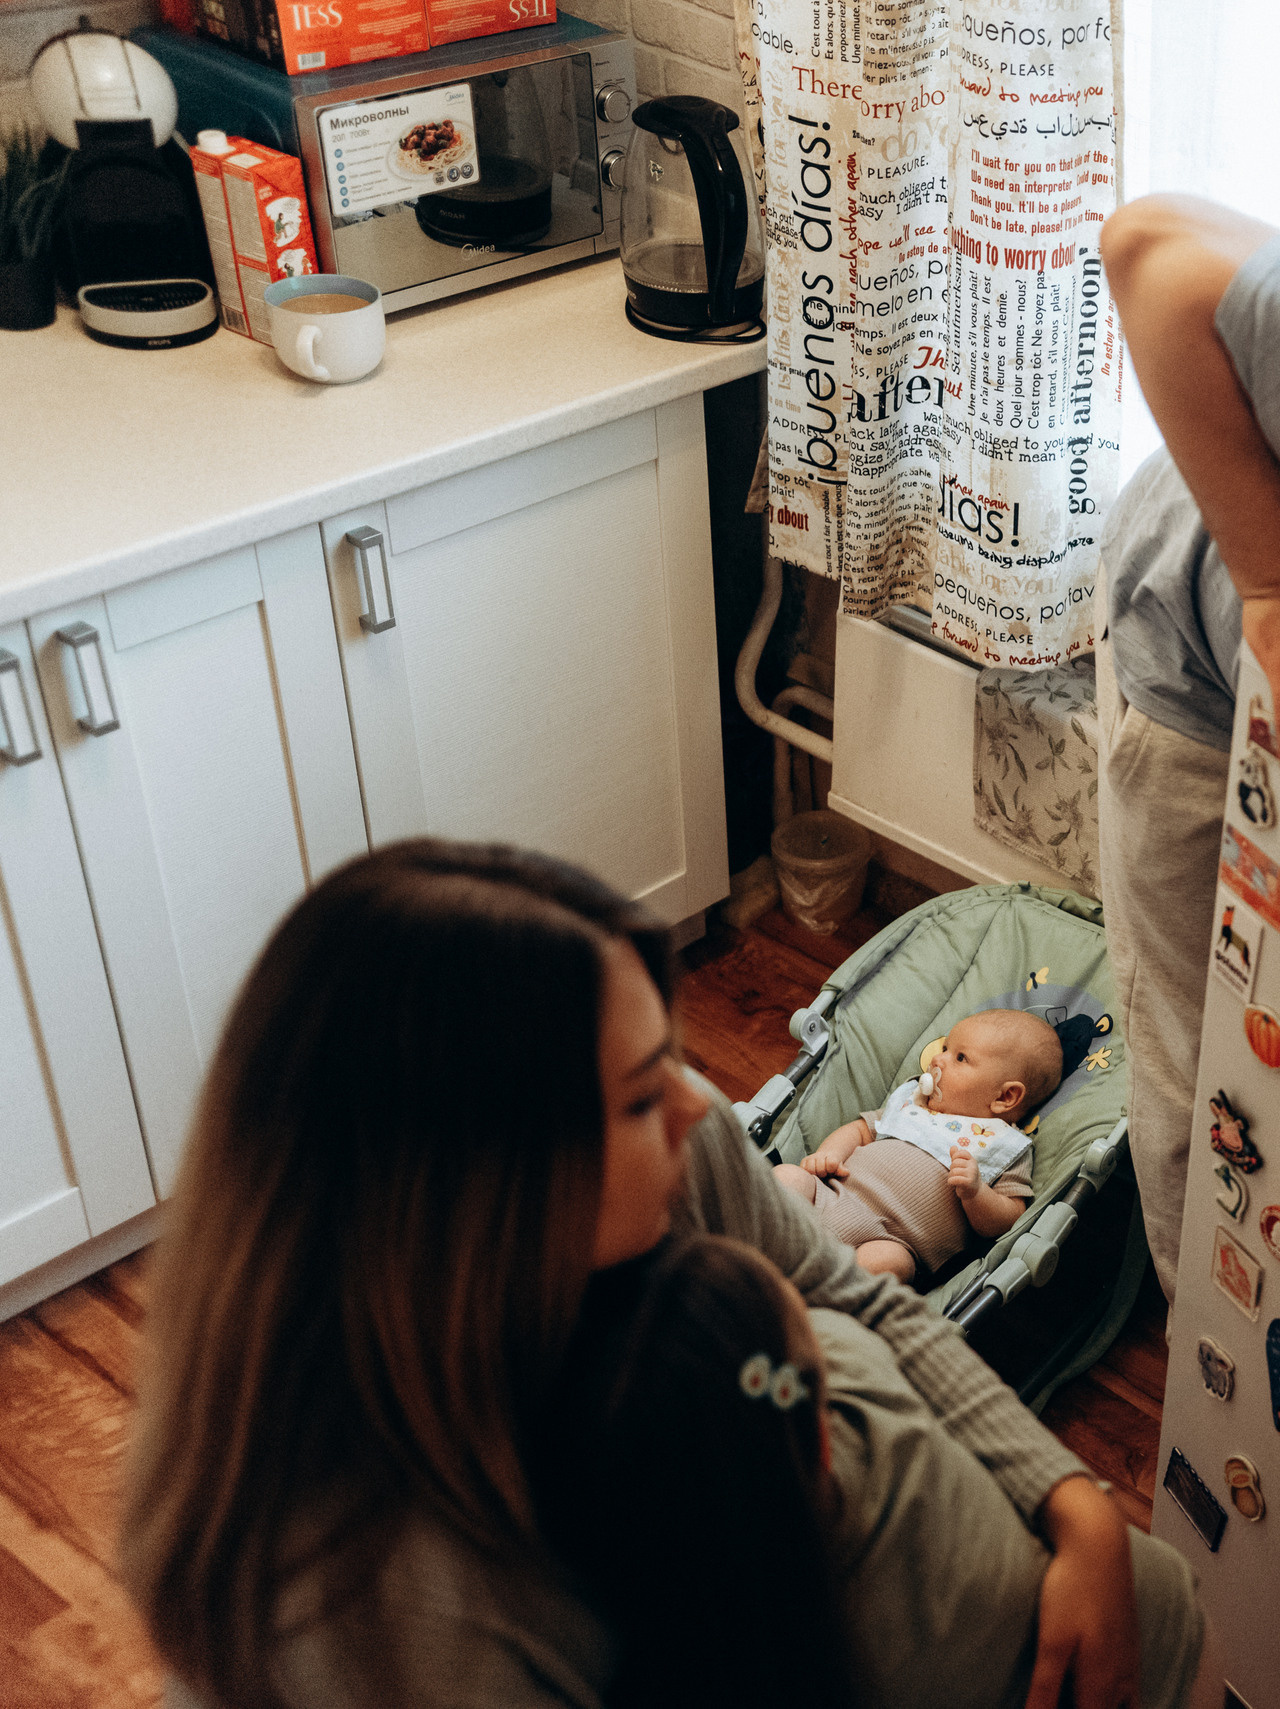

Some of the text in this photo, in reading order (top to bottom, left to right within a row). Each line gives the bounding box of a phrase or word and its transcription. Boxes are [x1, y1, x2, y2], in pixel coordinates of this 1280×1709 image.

[291, 3, 342, 31] TESS
[874, 2, 895, 13] jour
[875, 18, 897, 27] trop
[962, 14, 1090, 51] queños, por
[811, 35, 820, 58] C'est
[825, 50, 834, 60] Et
[852, 44, 861, 64] Une
[1000, 62, 1055, 77] PLEASE
[792, 65, 863, 101] There
[999, 83, 1104, 107] to meeting you
[329, 106, 409, 131] Микроволны
[867, 155, 929, 180] PLEASURE.
[971, 148, 1109, 176] I'll wait for you on that of the
[788, 113, 835, 254] días!
[899, 177, 935, 201] obliged
[971, 169, 982, 185] We
[984, 176, 1005, 191] need
[1008, 181, 1021, 193] an
[1024, 179, 1073, 197] interpreter
[1092, 172, 1109, 187] you
[902, 190, 931, 212] didn't
[971, 189, 1058, 214] Thank you. It'll be a
[914, 226, 936, 237] see
[970, 209, 989, 228] Don't
[991, 215, 1002, 231] be
[1031, 220, 1063, 237] please!
[461, 243, 496, 261] Midea
[783, 239, 798, 251] you
[928, 242, 939, 253] de
[986, 240, 1077, 274] to worry about
[907, 286, 933, 304] en
[911, 312, 939, 323] deux
[951, 243, 963, 375] Sei aufmerksam
[855, 342, 873, 356] Ne
[901, 331, 916, 348] pas
[919, 328, 934, 339] en
[967, 270, 979, 416] Une s'il vous plaît!
[979, 276, 993, 425] Je n'ai pas le temps. est
[1027, 270, 1048, 430] C'est trop tôt. Ne soyez pas
[1070, 256, 1102, 425] afternoon
[1101, 315, 1114, 376] No estoy de
[876, 353, 910, 378] PLEASE
[993, 290, 1008, 427] deux heures et demie.
[1010, 279, 1027, 429] Quel jour sommes nous?
[1048, 284, 1061, 429] en s'il vous plaît!
[775, 441, 803, 457] pas le
[869, 438, 891, 452] say
[971, 439, 1056, 463] I didn't mean
[973, 428, 1120, 452] obliged to you you
[850, 445, 923, 480] inappropriate
[769, 468, 791, 483] trop
[771, 484, 795, 498] plaît!
[977, 492, 1011, 511] again
[777, 504, 810, 532] about
[978, 544, 1013, 570] being
[934, 571, 1069, 624] pequeños, por
[936, 601, 1034, 645] ADDRESS, PLEASE
[941, 621, 1081, 667] forward to meeting you
